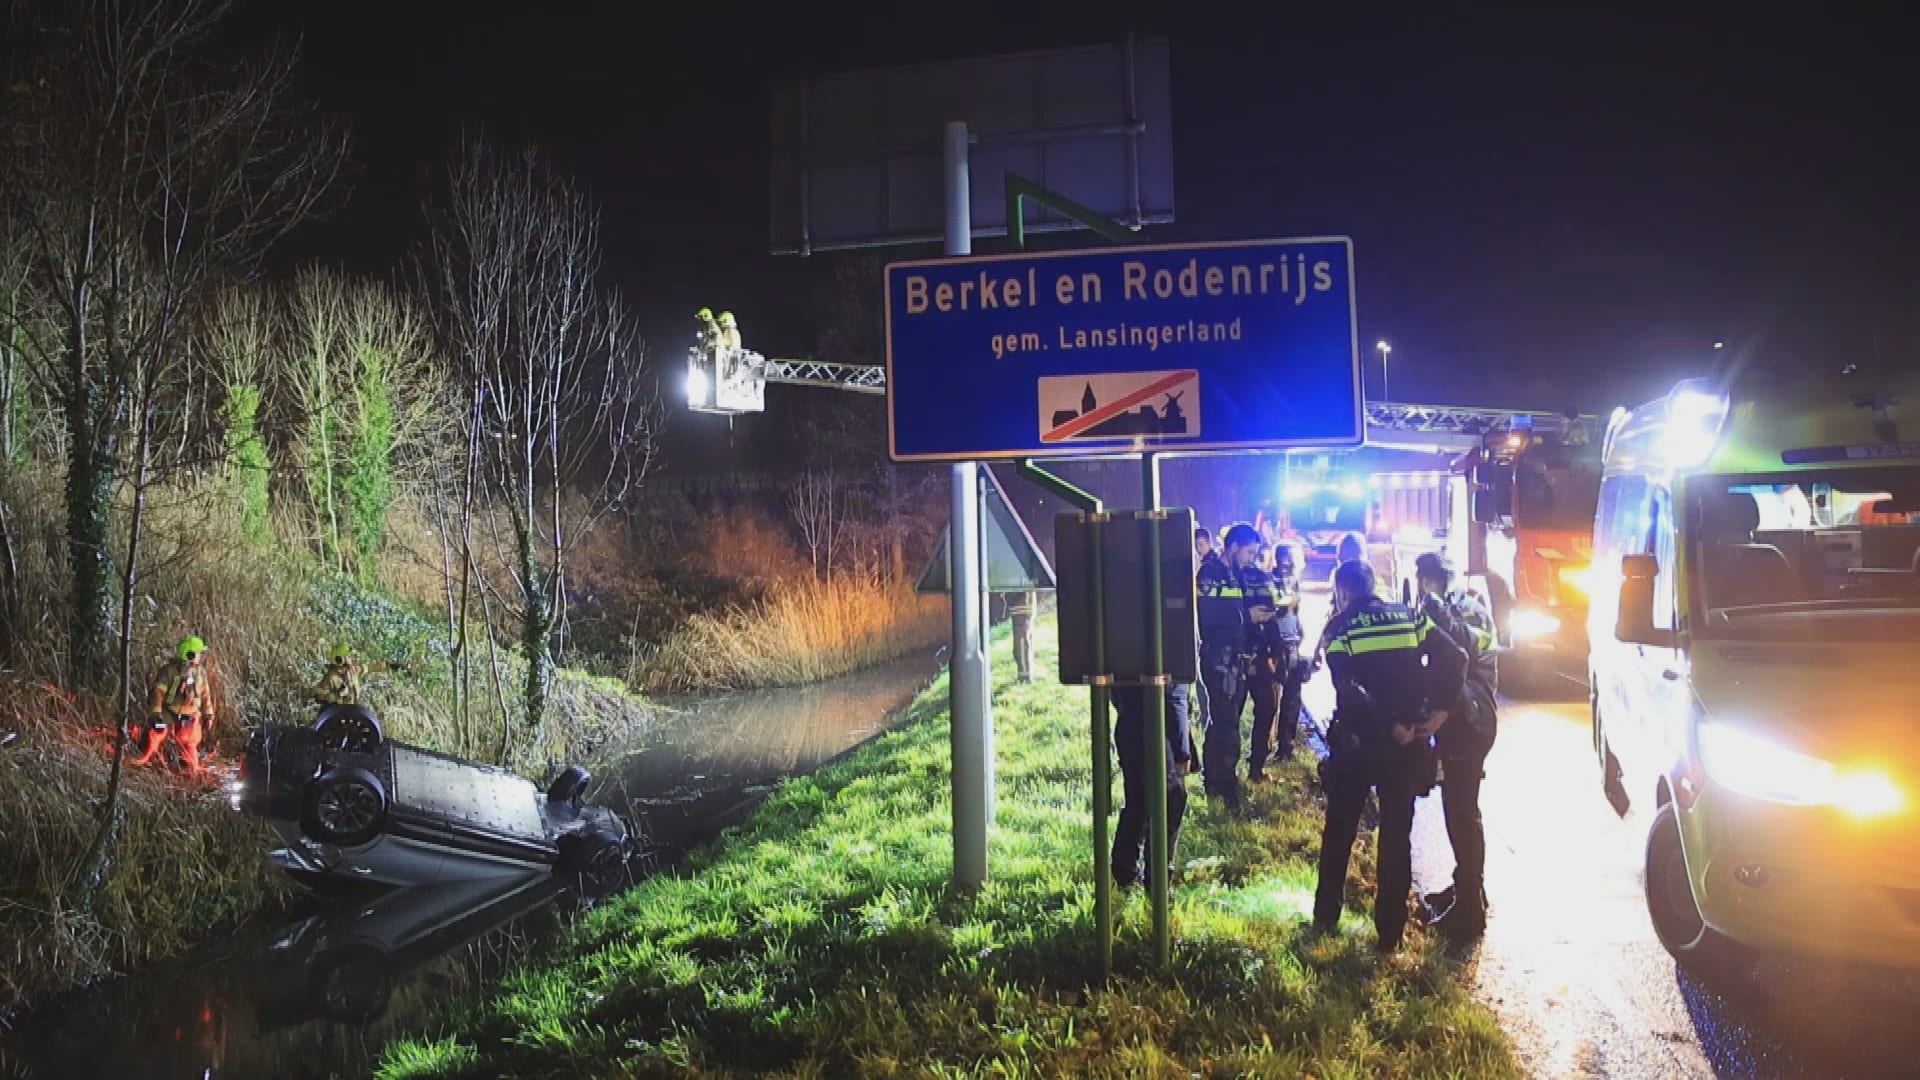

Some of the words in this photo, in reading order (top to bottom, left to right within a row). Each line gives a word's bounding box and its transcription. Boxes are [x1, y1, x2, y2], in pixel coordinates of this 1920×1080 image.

[906, 266, 1037, 315] Berkel
[1055, 272, 1102, 305] en
[1123, 252, 1333, 306] Rodenrijs
[991, 332, 1049, 360] gem.
[1059, 316, 1242, 352] Lansingerland
